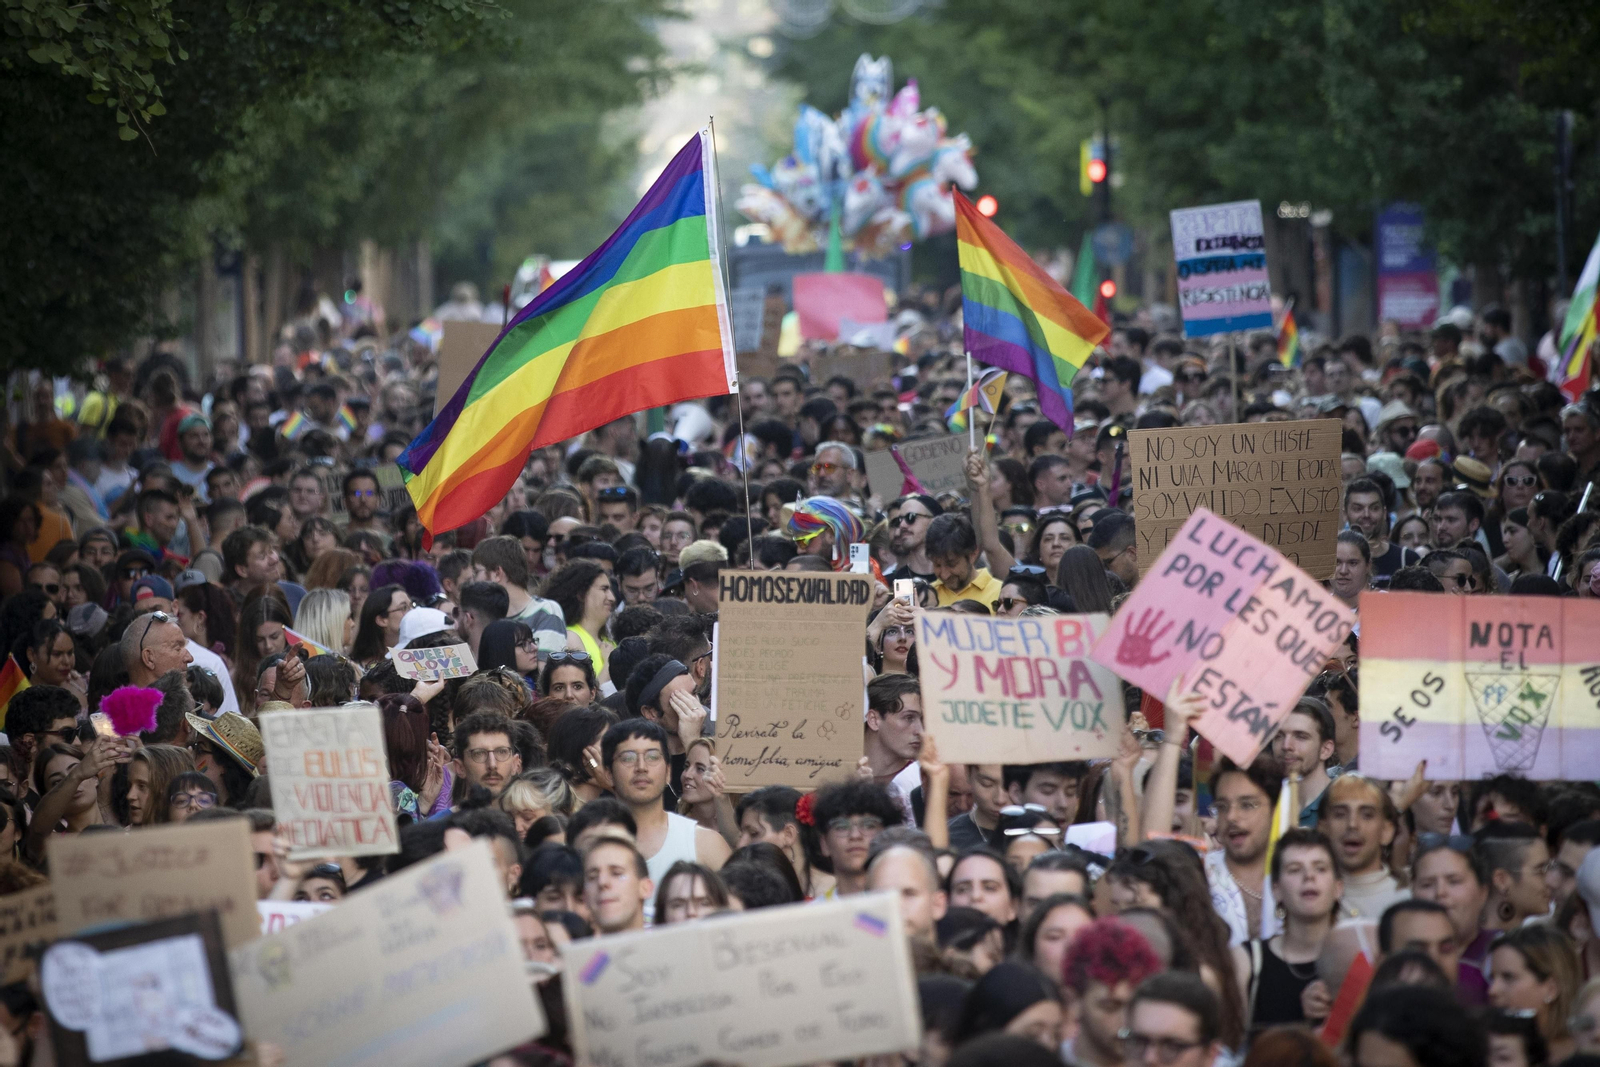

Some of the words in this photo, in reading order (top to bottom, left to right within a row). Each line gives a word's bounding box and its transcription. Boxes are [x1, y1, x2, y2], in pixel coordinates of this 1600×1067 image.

[1146, 437, 1175, 462] NO
[1183, 434, 1222, 460] SOY
[1232, 433, 1255, 454] UN
[1262, 429, 1321, 454] CHISTE
[1139, 466, 1159, 490] NI
[1170, 464, 1205, 487] UNA
[1212, 460, 1264, 485] MARCA
[1271, 460, 1289, 482] DE
[1298, 459, 1338, 481] ROPA
[1137, 492, 1180, 521] SOY
[1270, 487, 1340, 515] EXISTO
[1140, 527, 1157, 554] Y
[1263, 520, 1325, 546] DESDE
[719, 575, 870, 605] HOMOSEXUALIDAD
[1188, 518, 1351, 643] LUCHAMOS
[1162, 554, 1224, 598] POR
[1224, 587, 1278, 635] LES
[1276, 625, 1329, 676] QUE
[921, 616, 1050, 656] MUJER
[1175, 620, 1225, 661] NO
[1469, 622, 1554, 649] NOTA
[398, 647, 456, 662] QUEER
[414, 657, 462, 671] LOVE
[1500, 650, 1530, 671] EL
[433, 665, 471, 678] LIFE
[930, 652, 958, 690] Y
[973, 654, 1103, 700] MORA
[1379, 707, 1417, 743] SE
[1410, 671, 1445, 708] OS
[1483, 684, 1508, 704] PP
[939, 700, 1034, 729] JODETE
[1041, 701, 1108, 731] VOX
[1496, 681, 1547, 741] VOX
[267, 714, 369, 748] BASTA
[792, 719, 808, 740] la
[304, 747, 382, 778] BULOS
[294, 783, 394, 813] VIOLENCIA
